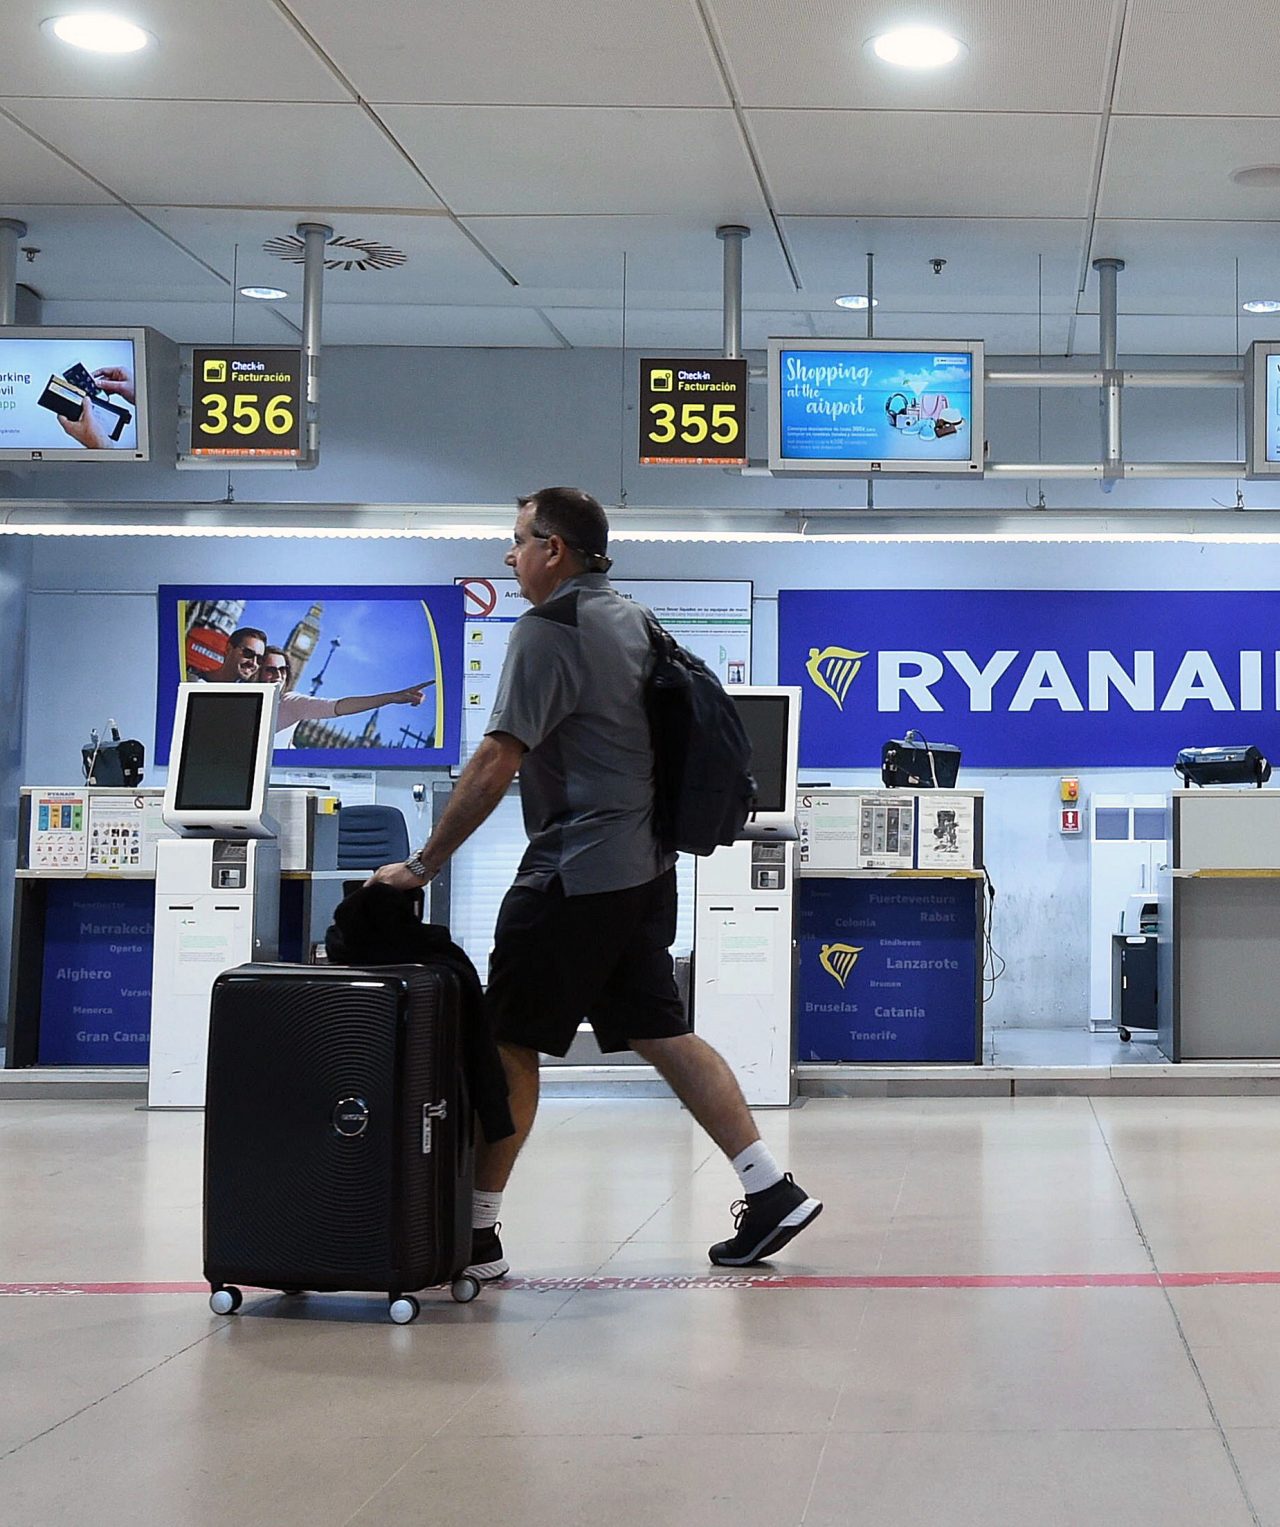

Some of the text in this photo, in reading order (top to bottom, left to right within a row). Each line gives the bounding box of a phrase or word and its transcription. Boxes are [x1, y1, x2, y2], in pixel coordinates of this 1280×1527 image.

[231, 361, 265, 371] Check-in
[231, 372, 291, 382] Facturación
[678, 371, 711, 380] Check-in
[786, 357, 872, 387] Shopping
[678, 381, 736, 391] Facturación
[787, 384, 819, 398] at the
[806, 394, 865, 421] airport
[200, 394, 293, 434] 356
[648, 403, 739, 444] 355
[920, 912, 956, 922] Rabat
[835, 918, 876, 927] Colonia
[109, 945, 143, 954] Oporto
[886, 957, 959, 969] Lanzarote
[56, 968, 112, 981] Alghero
[73, 1006, 113, 1014] Menorca
[805, 1002, 858, 1012] Bruselas
[874, 1007, 925, 1018] Catania
[76, 1031, 109, 1042] Gran
[850, 1030, 897, 1040] Tenerife
